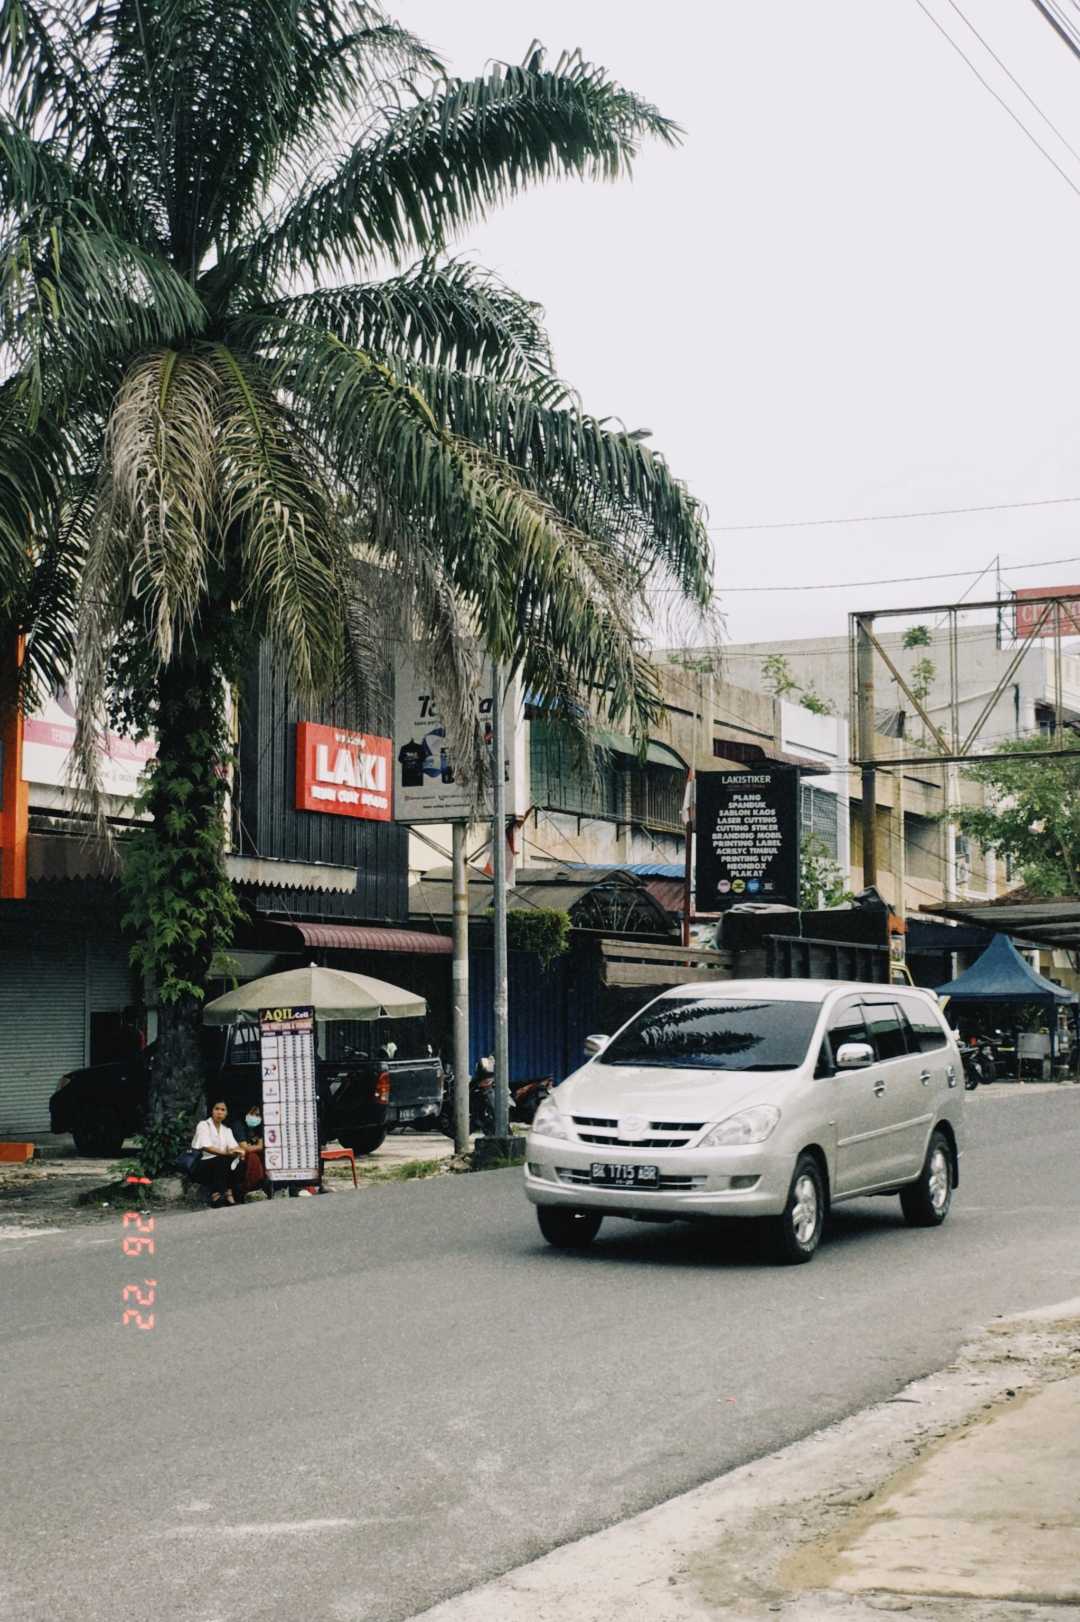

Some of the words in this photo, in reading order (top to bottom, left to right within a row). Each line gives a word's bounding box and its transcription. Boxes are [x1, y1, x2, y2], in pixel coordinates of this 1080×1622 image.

[315, 744, 387, 791] LAKI
[721, 775, 772, 784] LAKISTIKER
[727, 801, 767, 809] SPANDUK
[719, 809, 751, 817] SABLON
[743, 816, 778, 824] CUTTING
[715, 824, 750, 832] CUTTING
[711, 832, 754, 840] BRANDING
[720, 855, 759, 863] PRINTING
[726, 862, 767, 870] NEONBOX
[730, 870, 764, 878] PLAKAT
[264, 1008, 295, 1022] AQIL
[608, 1165, 635, 1179] 1715
